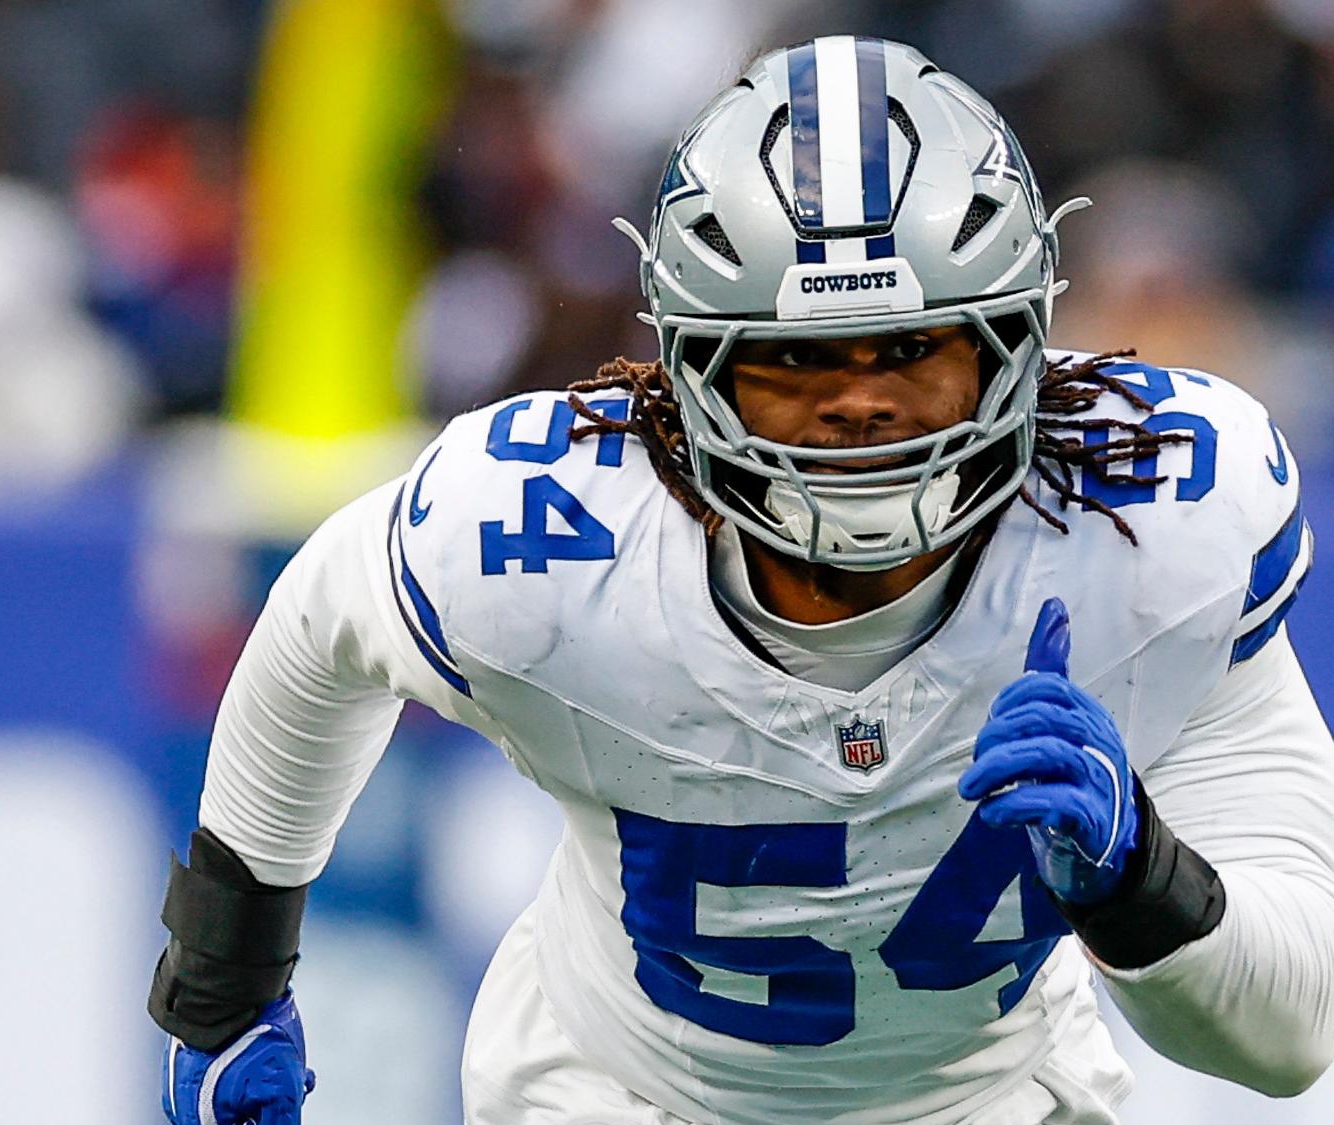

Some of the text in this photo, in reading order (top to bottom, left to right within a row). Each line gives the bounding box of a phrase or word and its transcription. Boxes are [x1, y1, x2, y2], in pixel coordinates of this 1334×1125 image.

[801, 271, 898, 294] COWBOYS
[479, 397, 632, 576] 54
[844, 742, 881, 764] NFL
[612, 805, 1072, 1047] 54
